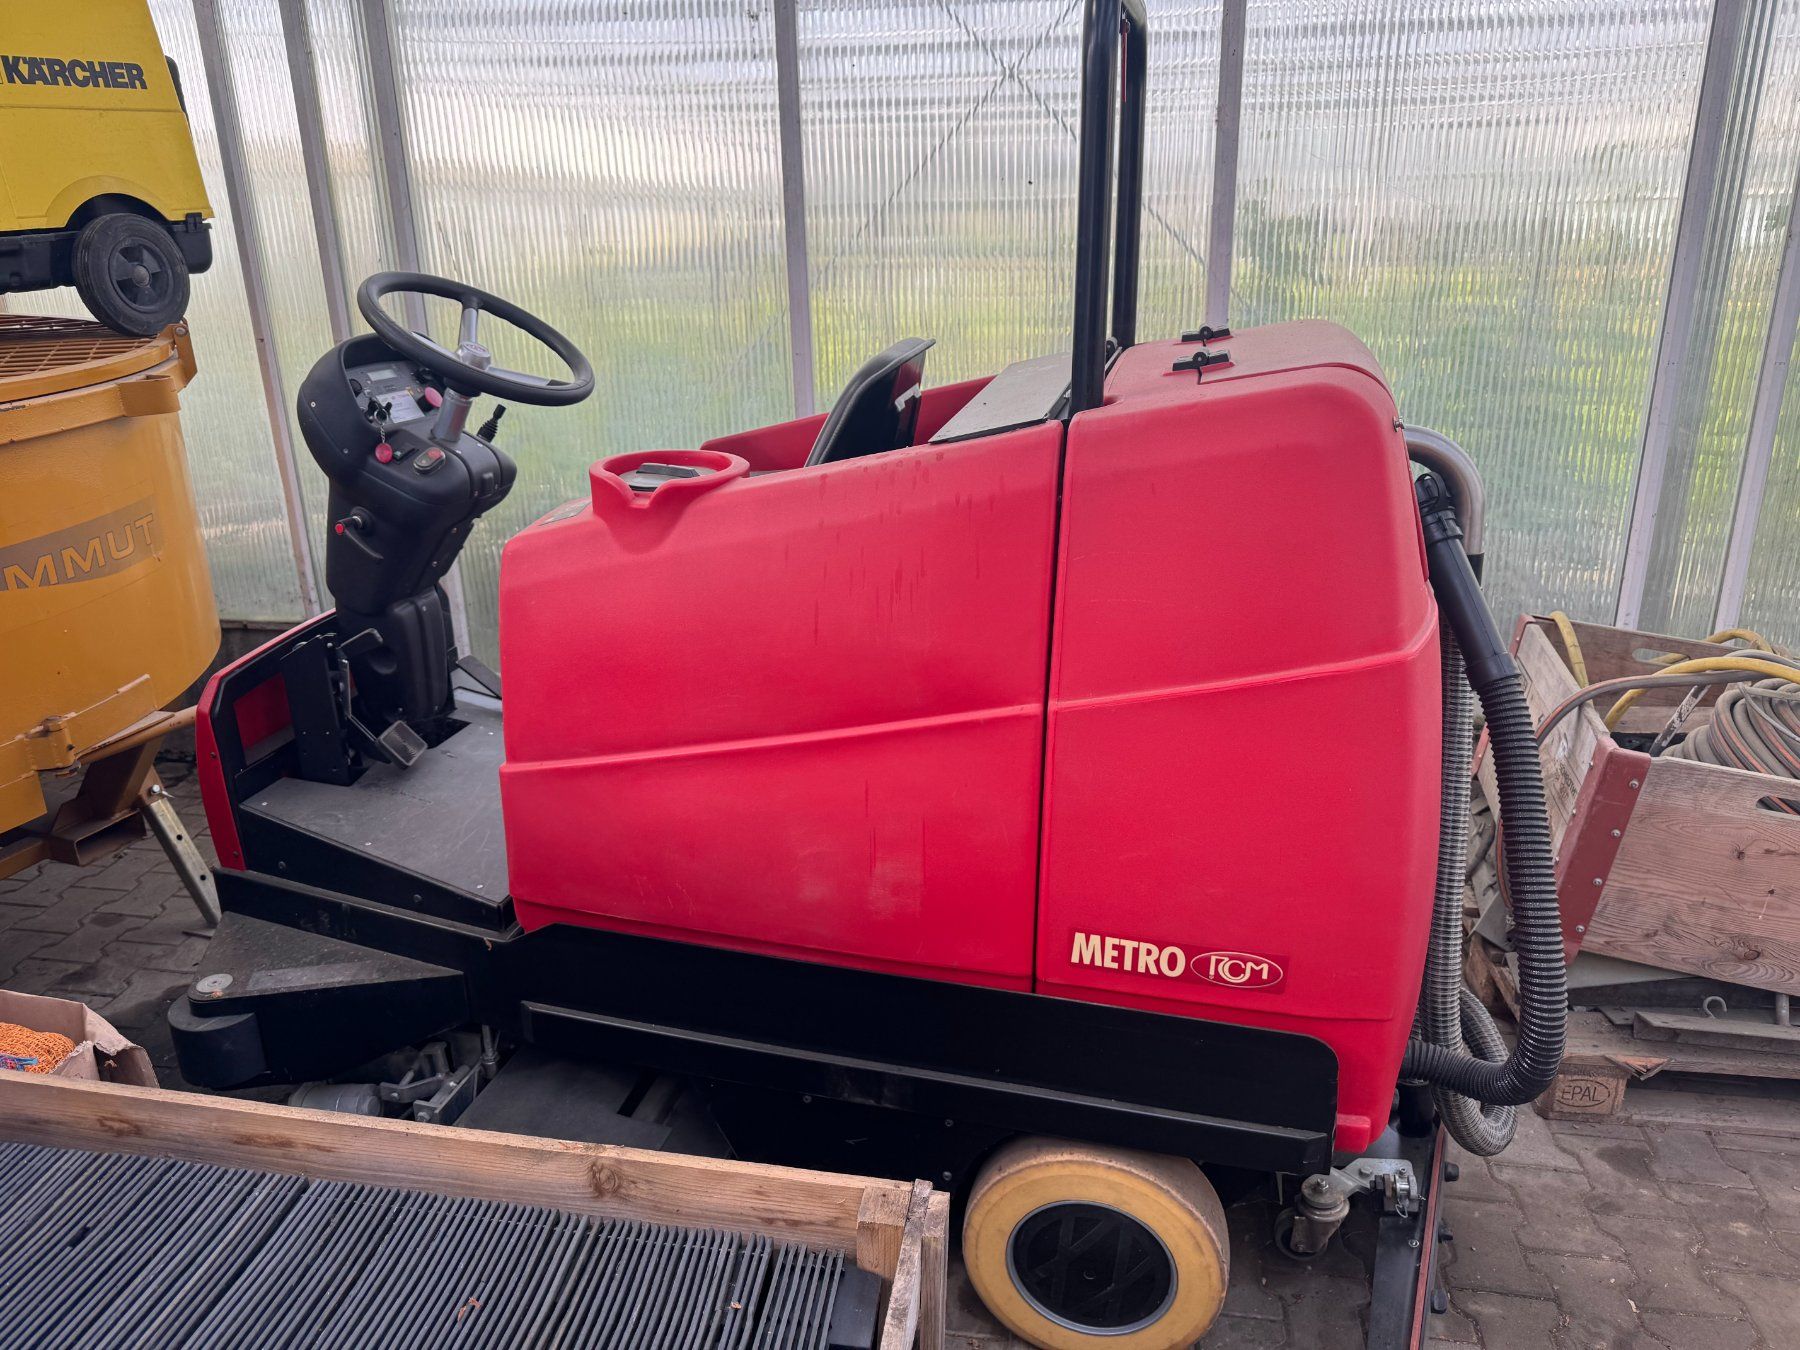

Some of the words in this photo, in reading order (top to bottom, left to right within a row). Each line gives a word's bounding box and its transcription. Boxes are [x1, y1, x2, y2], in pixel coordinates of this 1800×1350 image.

[0, 55, 148, 89] KÄRCHER
[1070, 931, 1186, 978] METRO
[1209, 955, 1269, 984] RCM
[1561, 1085, 1601, 1102] EPAL
